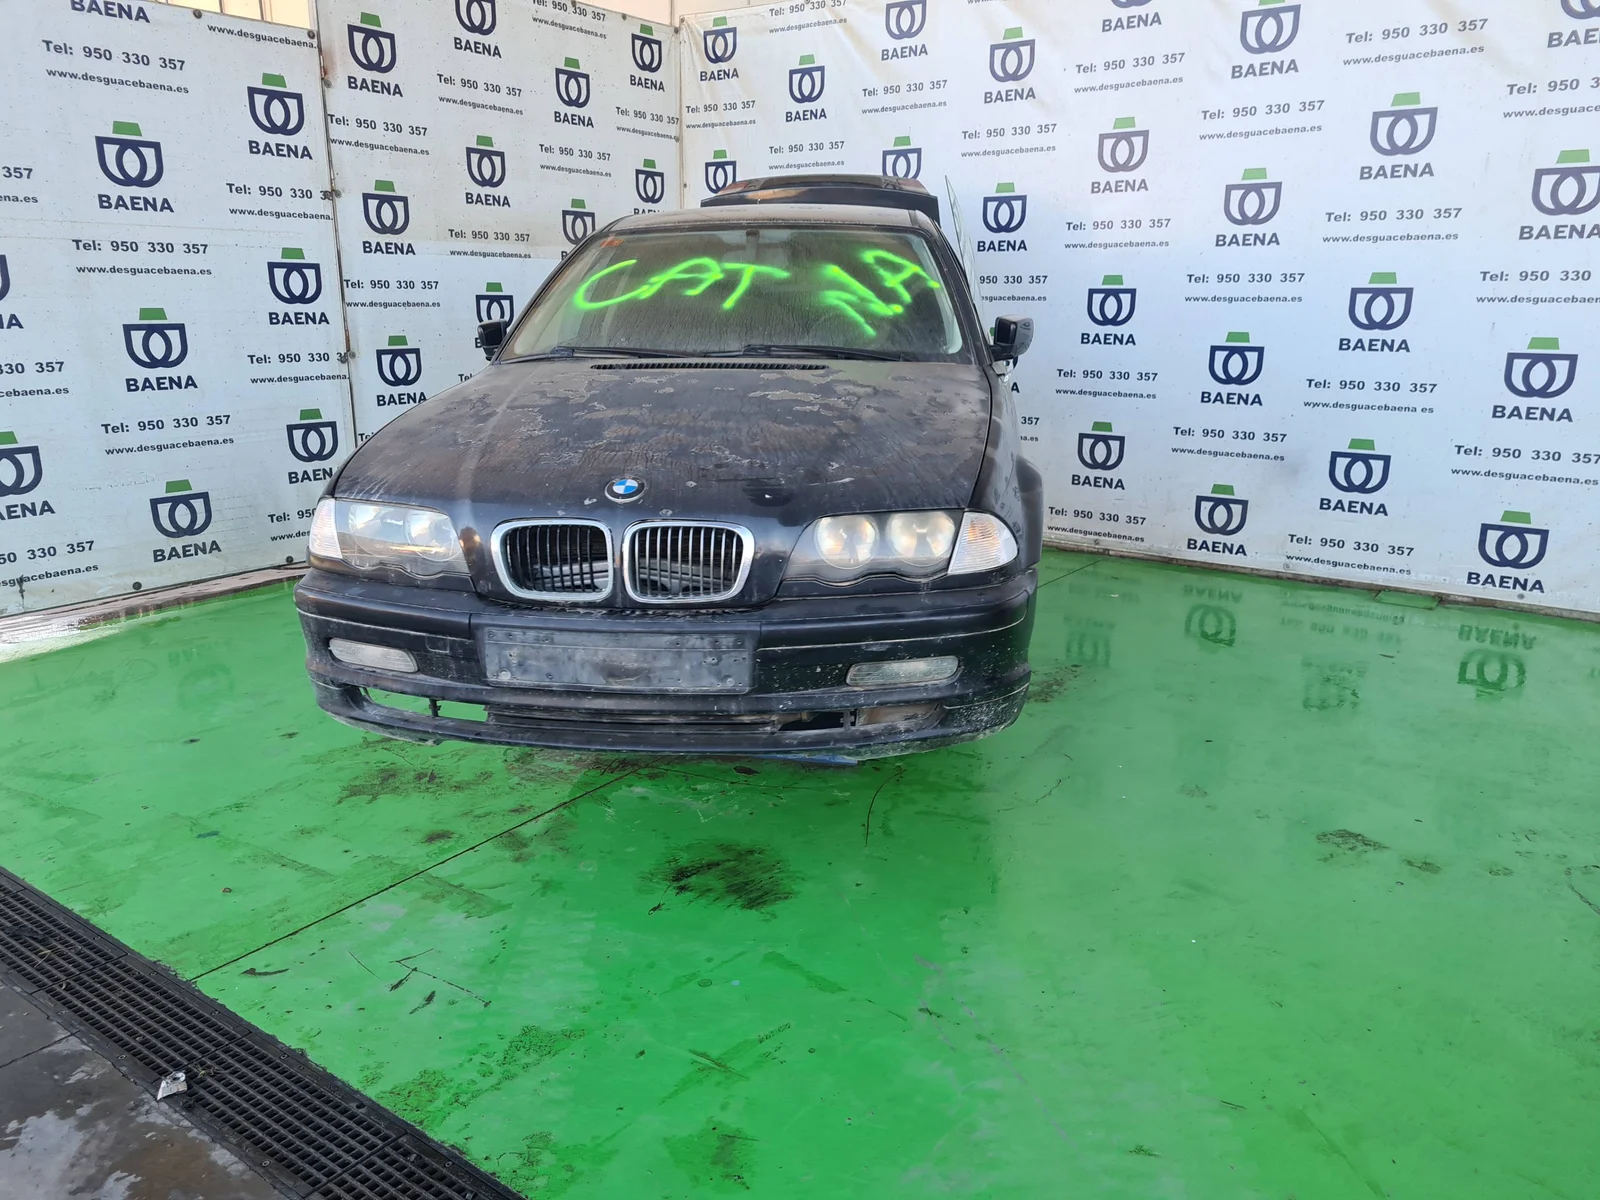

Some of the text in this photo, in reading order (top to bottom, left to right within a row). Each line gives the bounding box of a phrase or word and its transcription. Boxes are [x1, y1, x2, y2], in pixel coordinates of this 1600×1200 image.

[1102, 12, 1162, 32] BAENA
[1346, 18, 1488, 43] Tel: 950 330 357
[42, 40, 185, 70] Tel: 950 330 357
[454, 37, 501, 58] BAENA
[881, 44, 928, 61] BAENA
[1343, 46, 1484, 65] www.desguacebaena.es
[1076, 52, 1185, 73] Tel: 950 330 357
[1231, 59, 1299, 79] BAENA
[46, 69, 189, 93] www.desguacebaena.es
[700, 68, 739, 81] BAENA
[348, 76, 403, 97] BAENA
[437, 74, 521, 97] Tel: 950 330 357
[630, 75, 665, 92] BAENA
[862, 80, 947, 97] Tel: 950 330 357
[1074, 77, 1183, 93] www.desguacebaena.es
[984, 87, 1036, 103] BAENA
[686, 100, 755, 113] Tel: 950 330 357
[862, 101, 946, 114] www.desguacebaena.es
[1202, 100, 1325, 120] Tel: 950 330 357
[554, 111, 594, 128] BAENA
[786, 108, 827, 122] BAENA
[327, 114, 427, 136] Tel: 950 330 357
[962, 124, 1057, 139] Tel: 950 330 357
[1199, 125, 1322, 140] www.desguacebaena.es
[248, 140, 313, 160] BAENA
[539, 144, 610, 161] Tel: 950 330 357
[769, 141, 844, 155] Tel: 950 330 357
[1360, 163, 1434, 180] BAENA
[1091, 179, 1148, 194] BAENA
[98, 194, 174, 212] BAENA
[466, 192, 510, 207] BAENA
[1326, 208, 1462, 222] Tel: 950 330 357
[1066, 219, 1171, 230] Tel: 950 330 357
[448, 229, 530, 242] Tel: 950 330 357
[1215, 233, 1280, 247] BAENA
[1323, 233, 1458, 243] www.desguacebaena.es
[72, 239, 208, 254] Tel: 950 330 357
[363, 241, 416, 255] BAENA
[977, 240, 1027, 252] BAENA
[1065, 241, 1169, 249] www.desguacebaena.es
[450, 250, 531, 258] www.desguacebaena.es
[76, 266, 212, 276] www.desguacebaena.es
[1187, 273, 1305, 283] Tel: 950 330 357
[1480, 270, 1591, 281] Tel: 950 330
[344, 279, 438, 289] Tel: 950 330 357
[346, 299, 440, 309] www.desguacebaena.es
[1185, 295, 1302, 303] www.desguacebaena.es
[269, 312, 330, 325] BAENA
[1081, 333, 1136, 345] BAENA
[1339, 338, 1410, 352] BAENA
[247, 355, 271, 364] Tel:
[278, 353, 300, 363] 950
[308, 353, 329, 362] 330
[1057, 369, 1158, 381] Tel: 950 330 357
[125, 375, 198, 392] BAENA
[1306, 379, 1437, 393] Tel: 950 330 357
[1056, 389, 1156, 399] www.desguacebaena.es
[1201, 392, 1262, 406] BAENA
[1492, 405, 1573, 422] BAENA
[101, 415, 230, 434] Tel: 950 330 357
[1173, 427, 1287, 442] Tel: 950 330 357
[105, 438, 234, 455] www.desguacebaena.es
[1172, 448, 1284, 461] www.desguacebaena.es
[1455, 445, 1600, 464] Tel: 950 330 357
[1072, 474, 1125, 490] BAENA
[1451, 469, 1598, 485] www.desguacebaena.es
[1320, 498, 1388, 516] BAENA
[1049, 507, 1146, 525] Tel: 950 330 357
[1047, 525, 1144, 543] www.desguacebaena.es
[153, 540, 221, 562] BAENA
[1187, 538, 1247, 556] BAENA
[1288, 534, 1414, 556] Tel: 950 330 357
[1286, 555, 1411, 575] www.desguacebaena.es
[1467, 572, 1544, 593] BAENA
